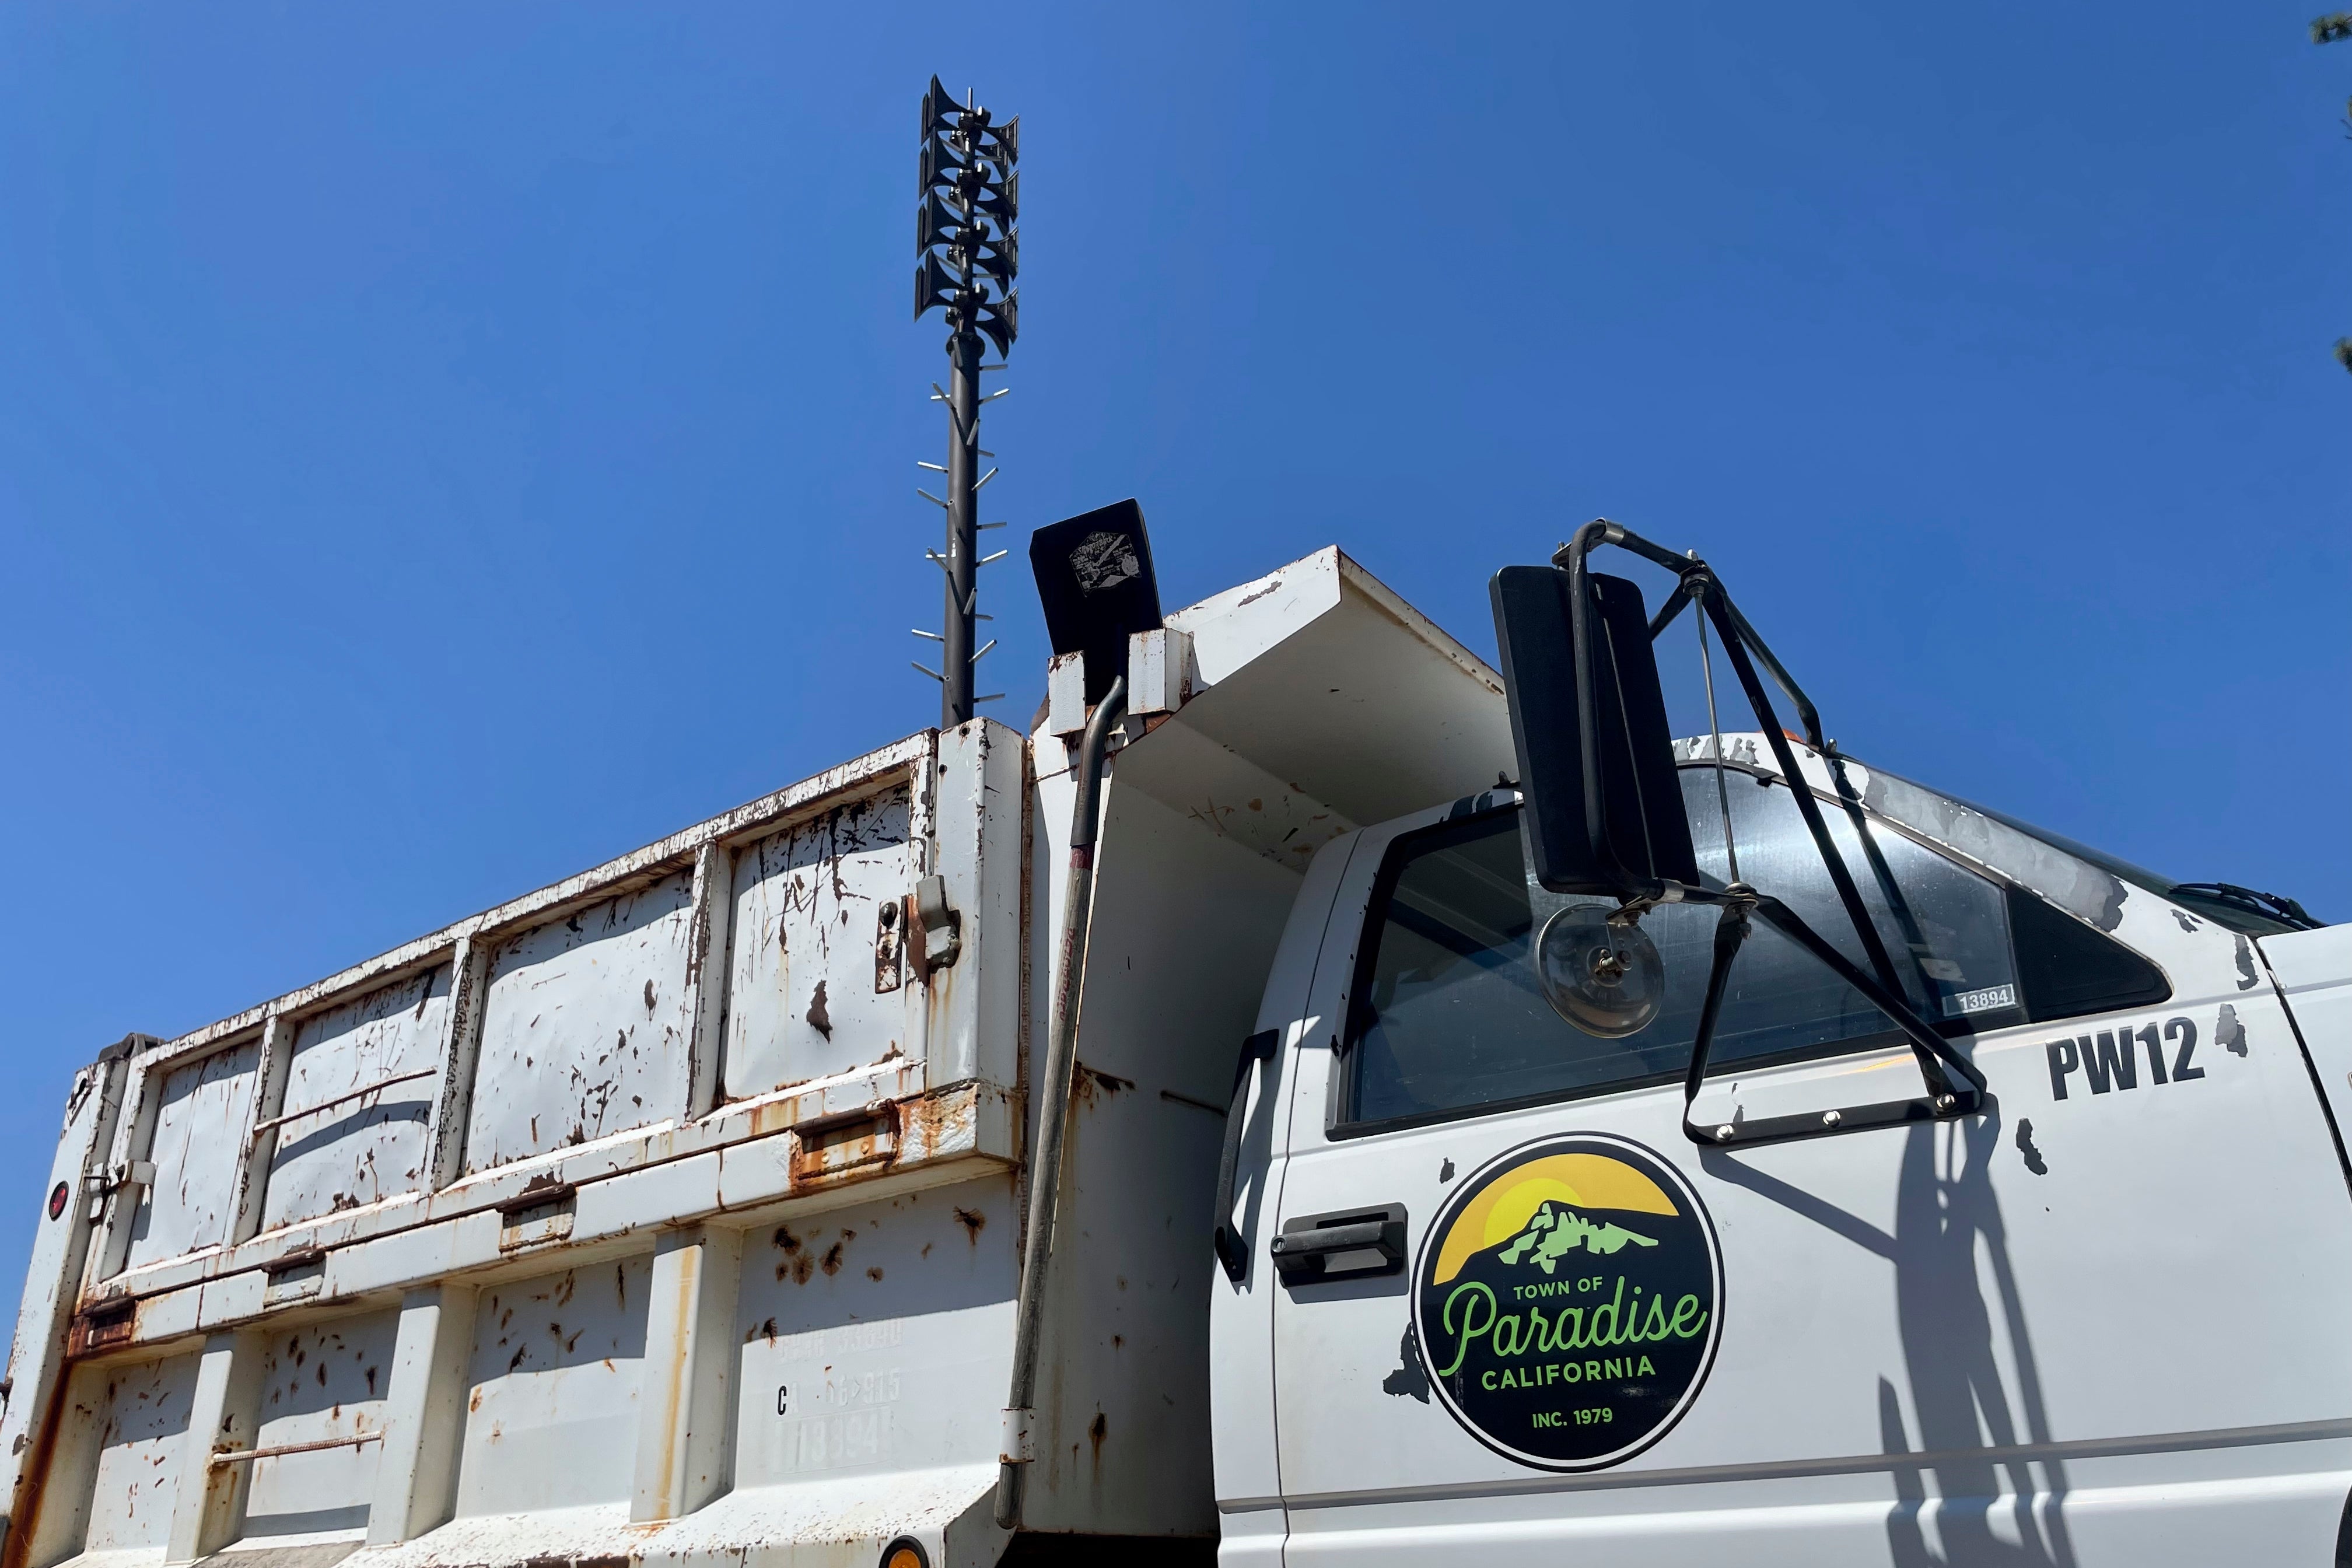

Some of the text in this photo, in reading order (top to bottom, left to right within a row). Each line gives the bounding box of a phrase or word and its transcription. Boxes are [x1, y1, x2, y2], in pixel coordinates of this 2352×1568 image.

[1959, 989, 2008, 1010] 13894
[2046, 1017, 2206, 1101] PW12
[1513, 1276, 1603, 1300] TOWN OF
[1438, 1276, 1709, 1377] Paradise
[1482, 1356, 1656, 1391] CALIFORNIA
[1532, 1408, 1613, 1428] INC. 1979
